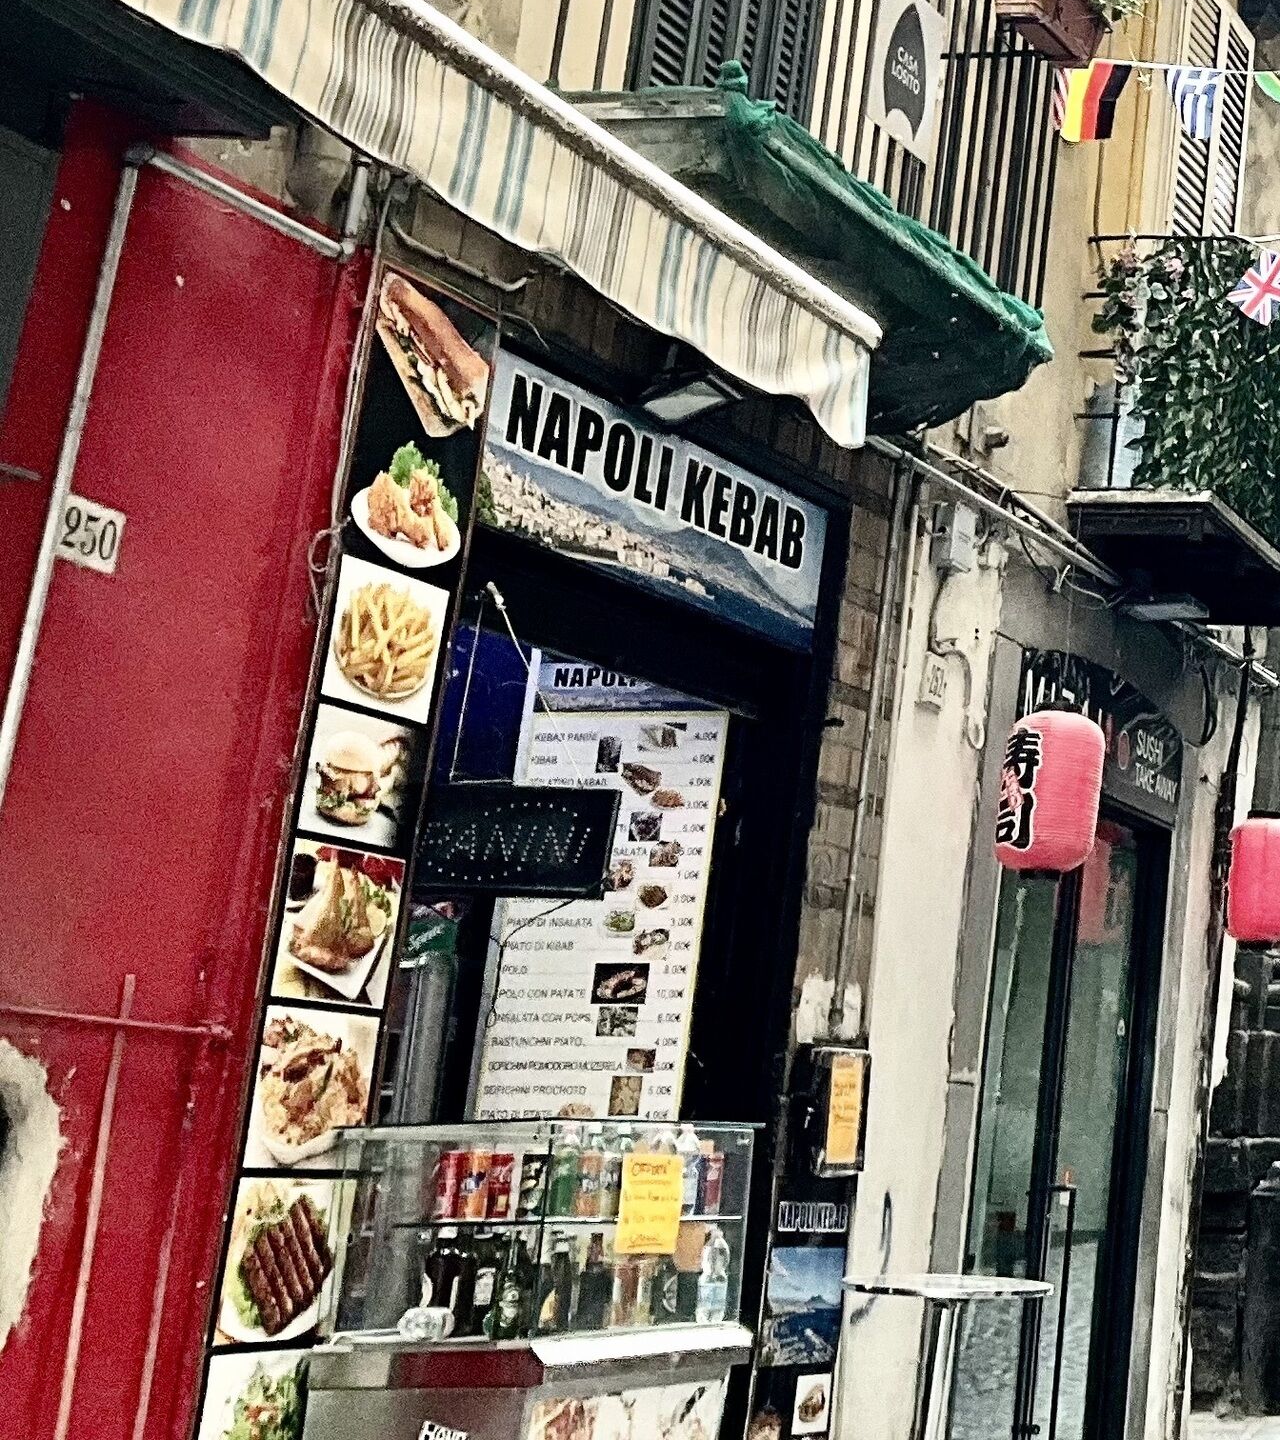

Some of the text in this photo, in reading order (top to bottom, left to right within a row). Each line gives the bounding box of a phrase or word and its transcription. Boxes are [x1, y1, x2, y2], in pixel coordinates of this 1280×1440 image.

[505, 373, 806, 570] NAPOLI KEBAB
[61, 506, 117, 561] 250
[1136, 729, 1163, 766] SUSHI
[1135, 762, 1155, 794] TAKE
[420, 821, 591, 864] PANINI
